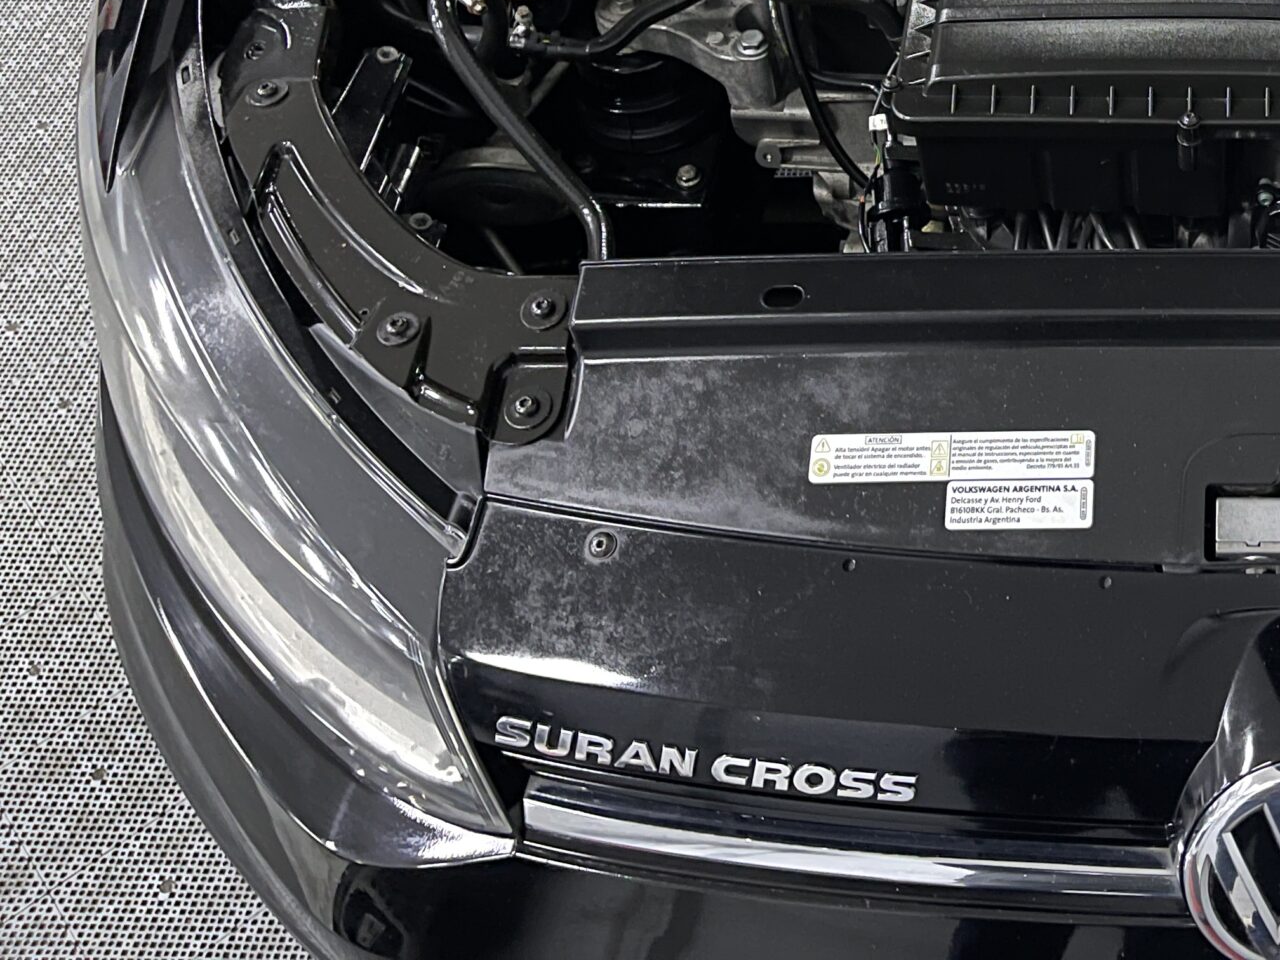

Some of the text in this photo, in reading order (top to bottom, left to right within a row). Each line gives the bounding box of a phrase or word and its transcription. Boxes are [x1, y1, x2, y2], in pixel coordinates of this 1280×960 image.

[1002, 496, 1024, 505] Henry
[984, 516, 1020, 525] Argentina
[494, 715, 919, 803] SURAN CROSS
